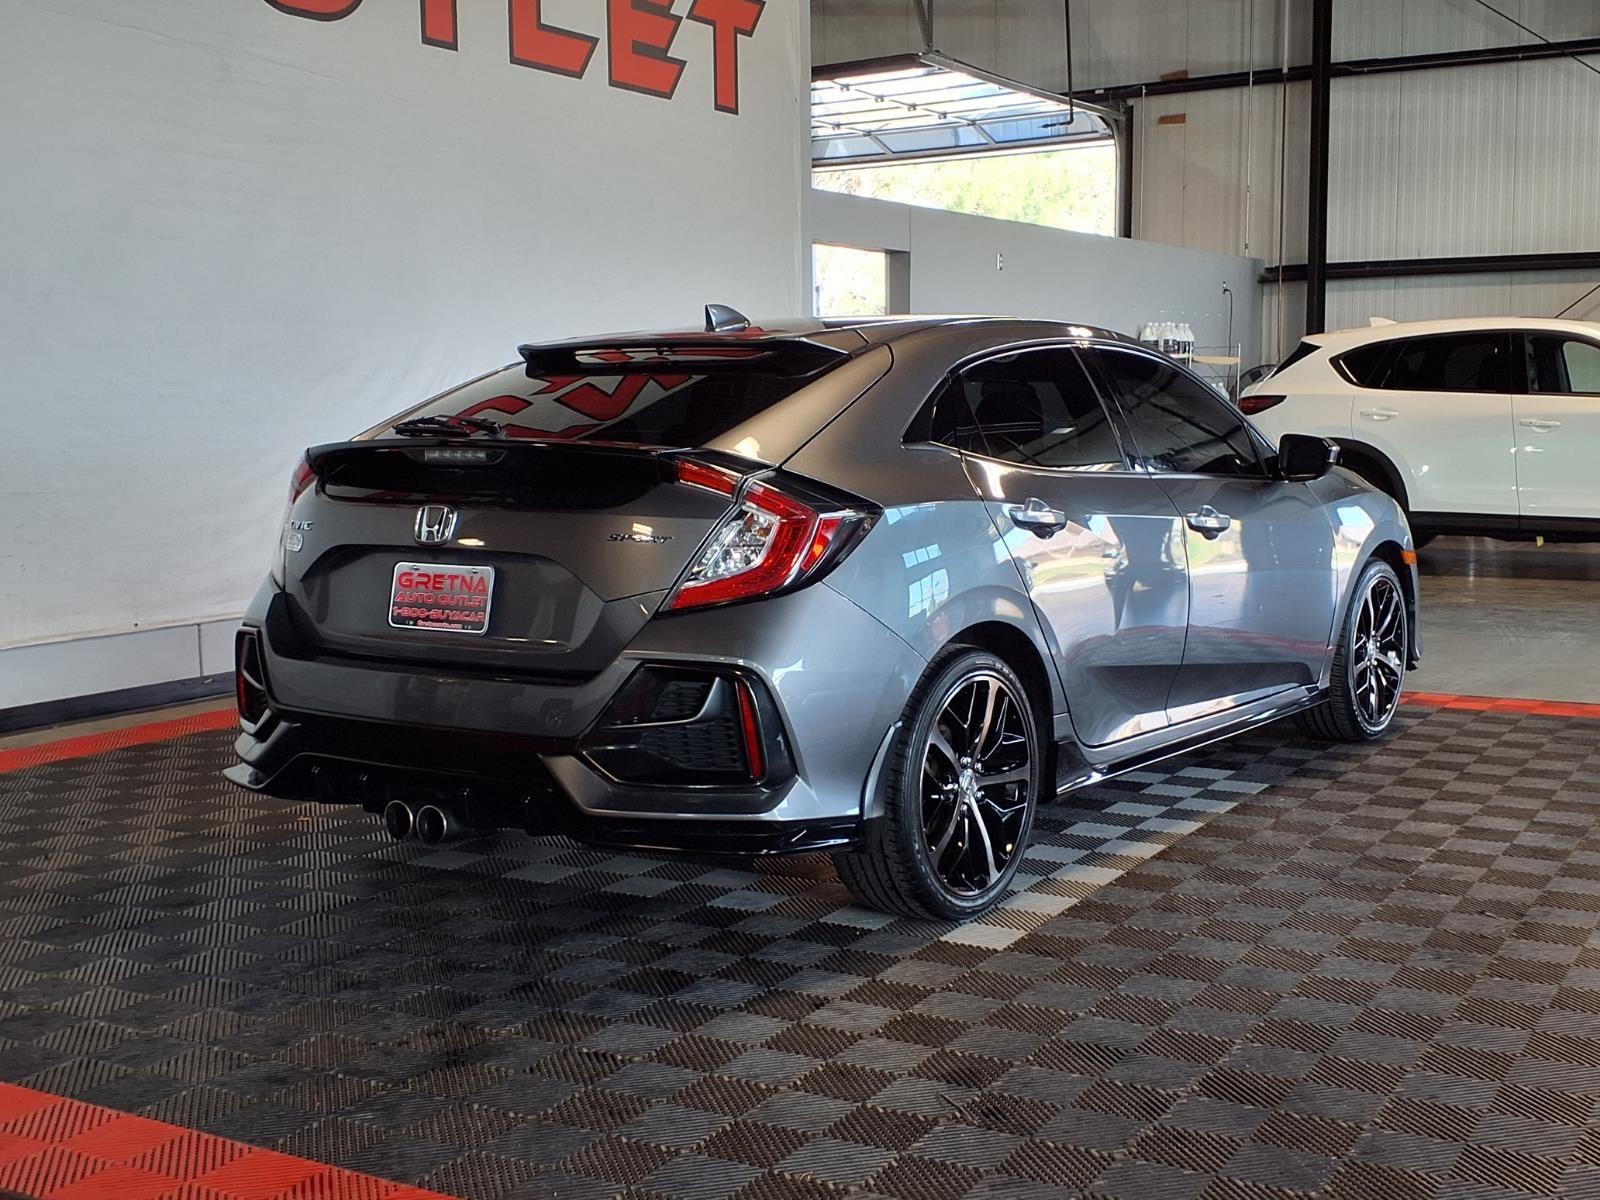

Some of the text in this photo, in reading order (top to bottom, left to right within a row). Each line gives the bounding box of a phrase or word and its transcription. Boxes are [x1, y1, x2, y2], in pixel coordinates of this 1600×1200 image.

[398, 571, 489, 593] GRETNA
[394, 591, 488, 607] AUTO OUTLET
